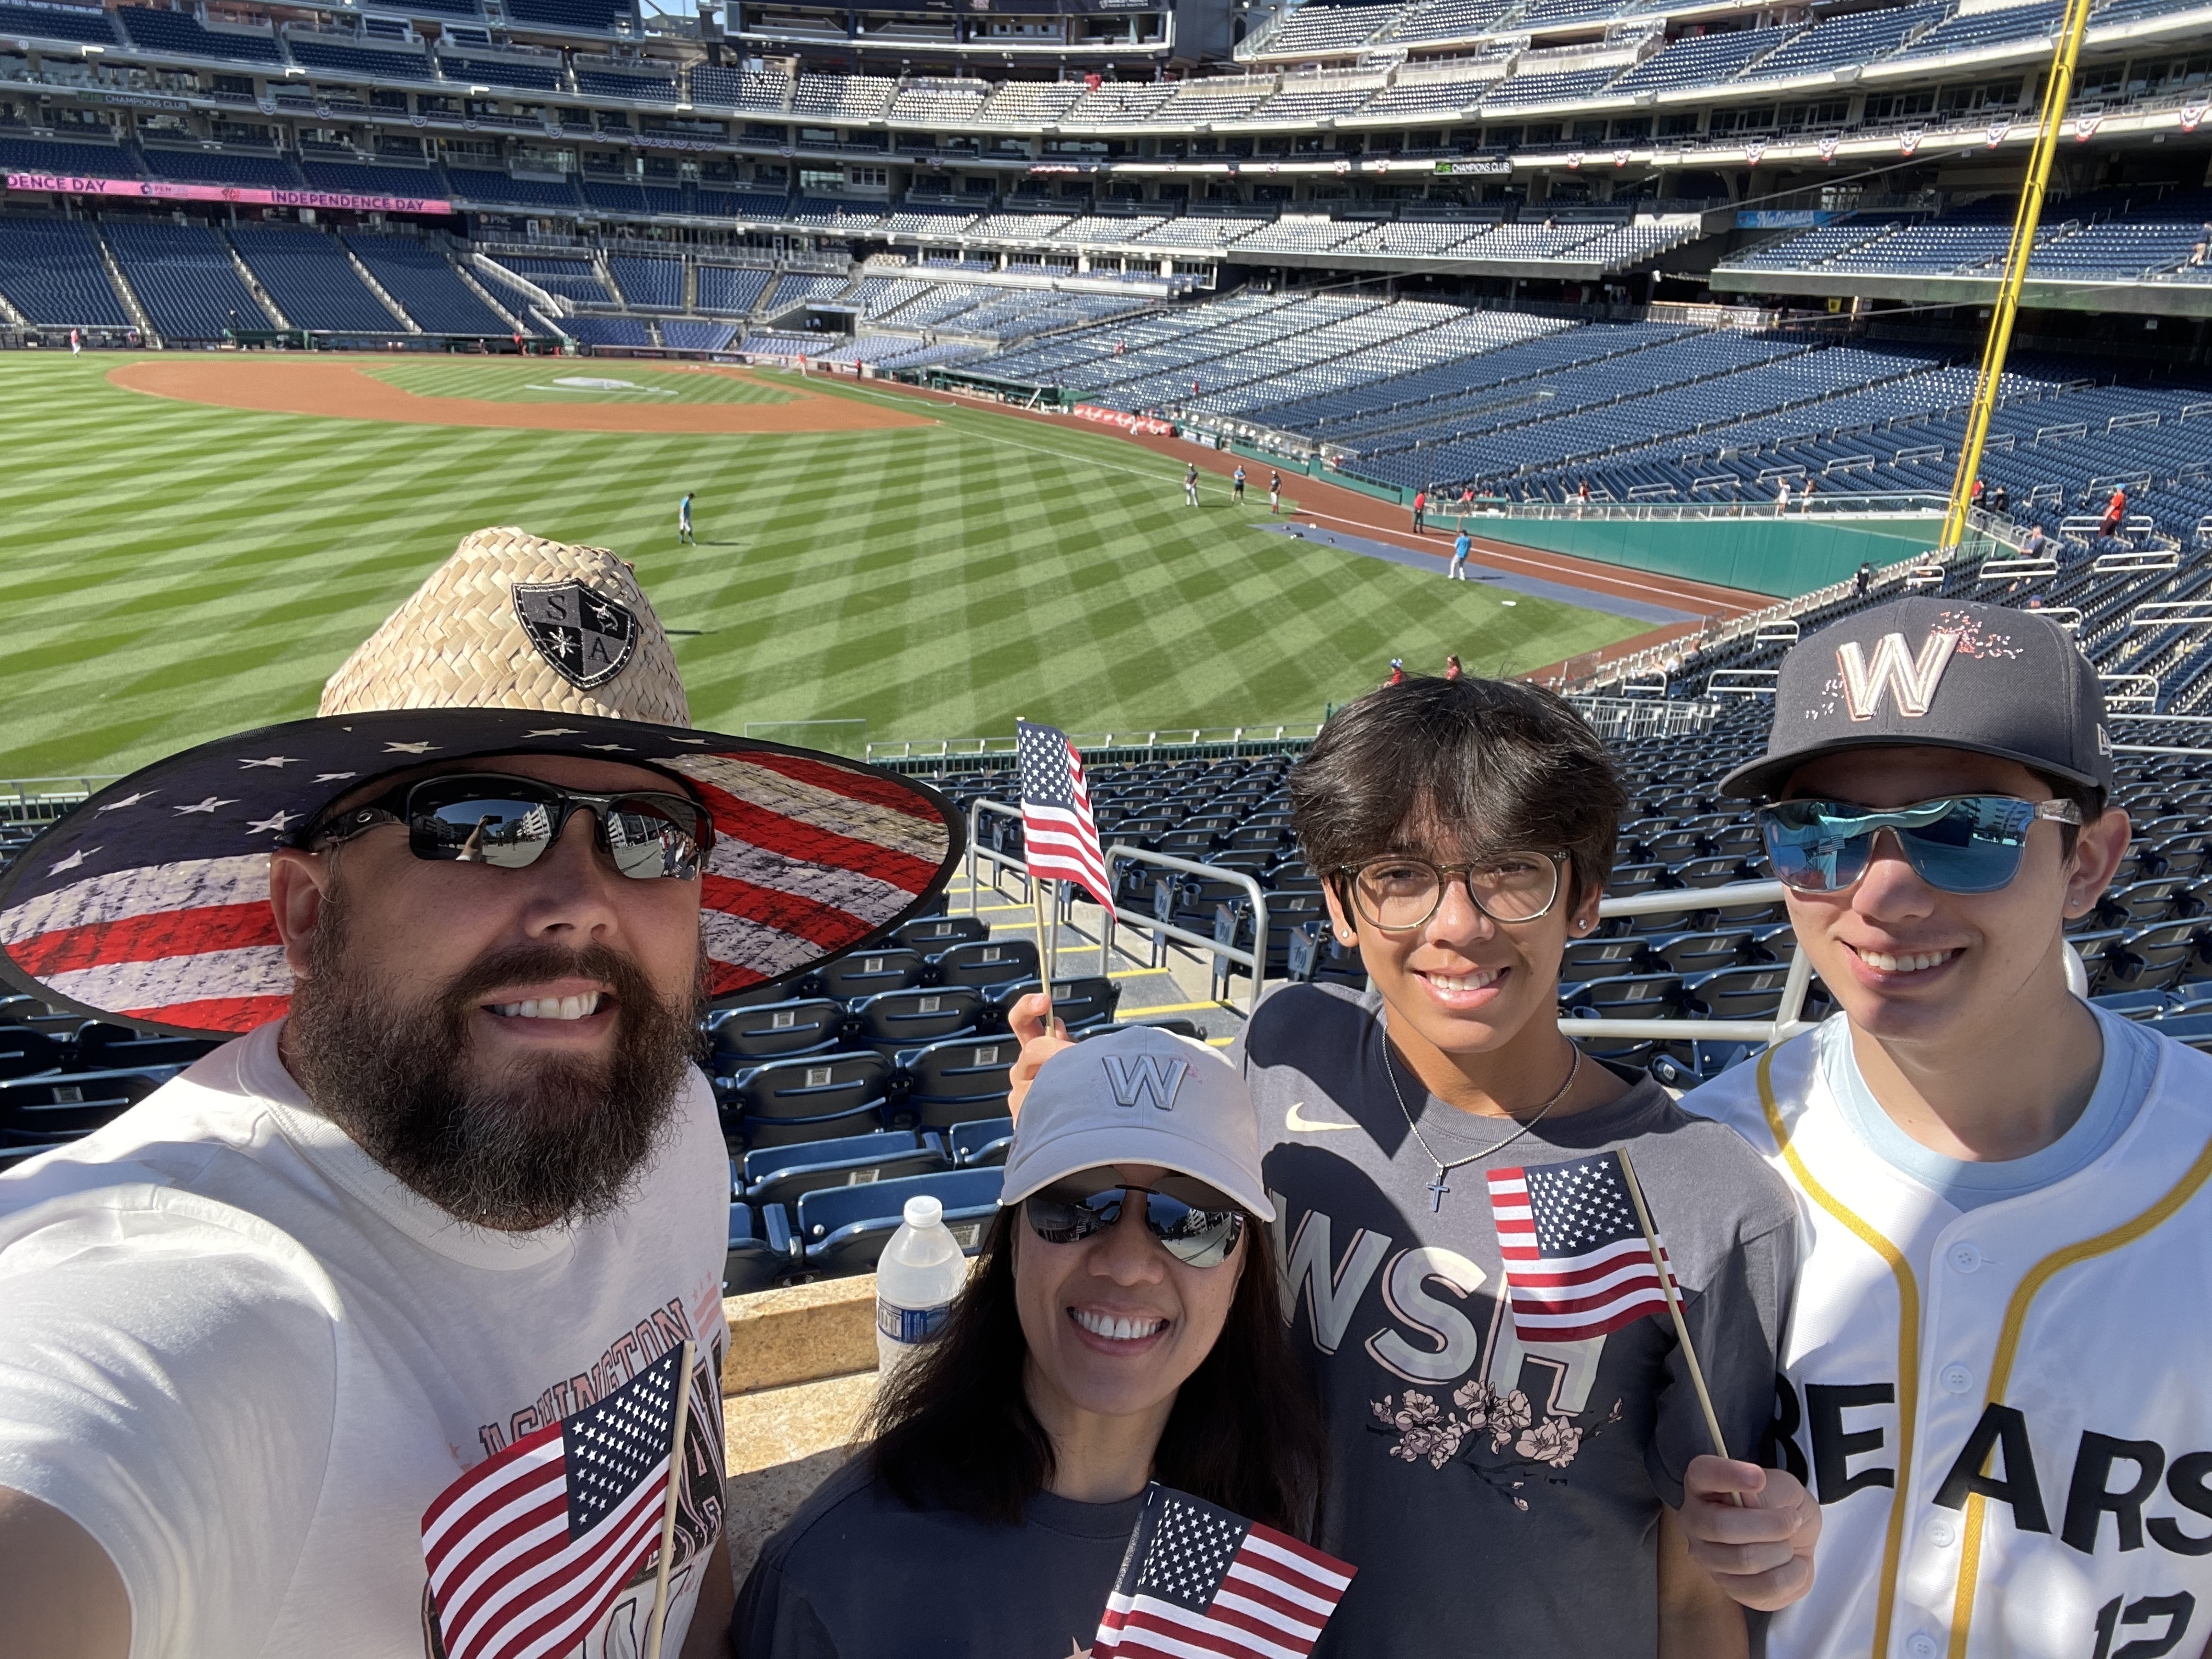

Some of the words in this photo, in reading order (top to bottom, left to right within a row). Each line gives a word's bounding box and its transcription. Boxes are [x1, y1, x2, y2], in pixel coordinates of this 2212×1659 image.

[105, 94, 161, 108] CHAMPIONS
[163, 100, 188, 110] CLUB
[1452, 162, 1491, 173] CHAMPIONS
[1491, 162, 1509, 172] CLUB
[72, 177, 106, 192] DAY
[271, 190, 391, 210] INDEPENDENCE
[396, 199, 425, 211] DAY
[546, 593, 567, 621] S
[585, 636, 613, 664] A
[1836, 631, 1961, 723] W
[1101, 1054, 1189, 1111] W
[2092, 1590, 2196, 1659] 12
